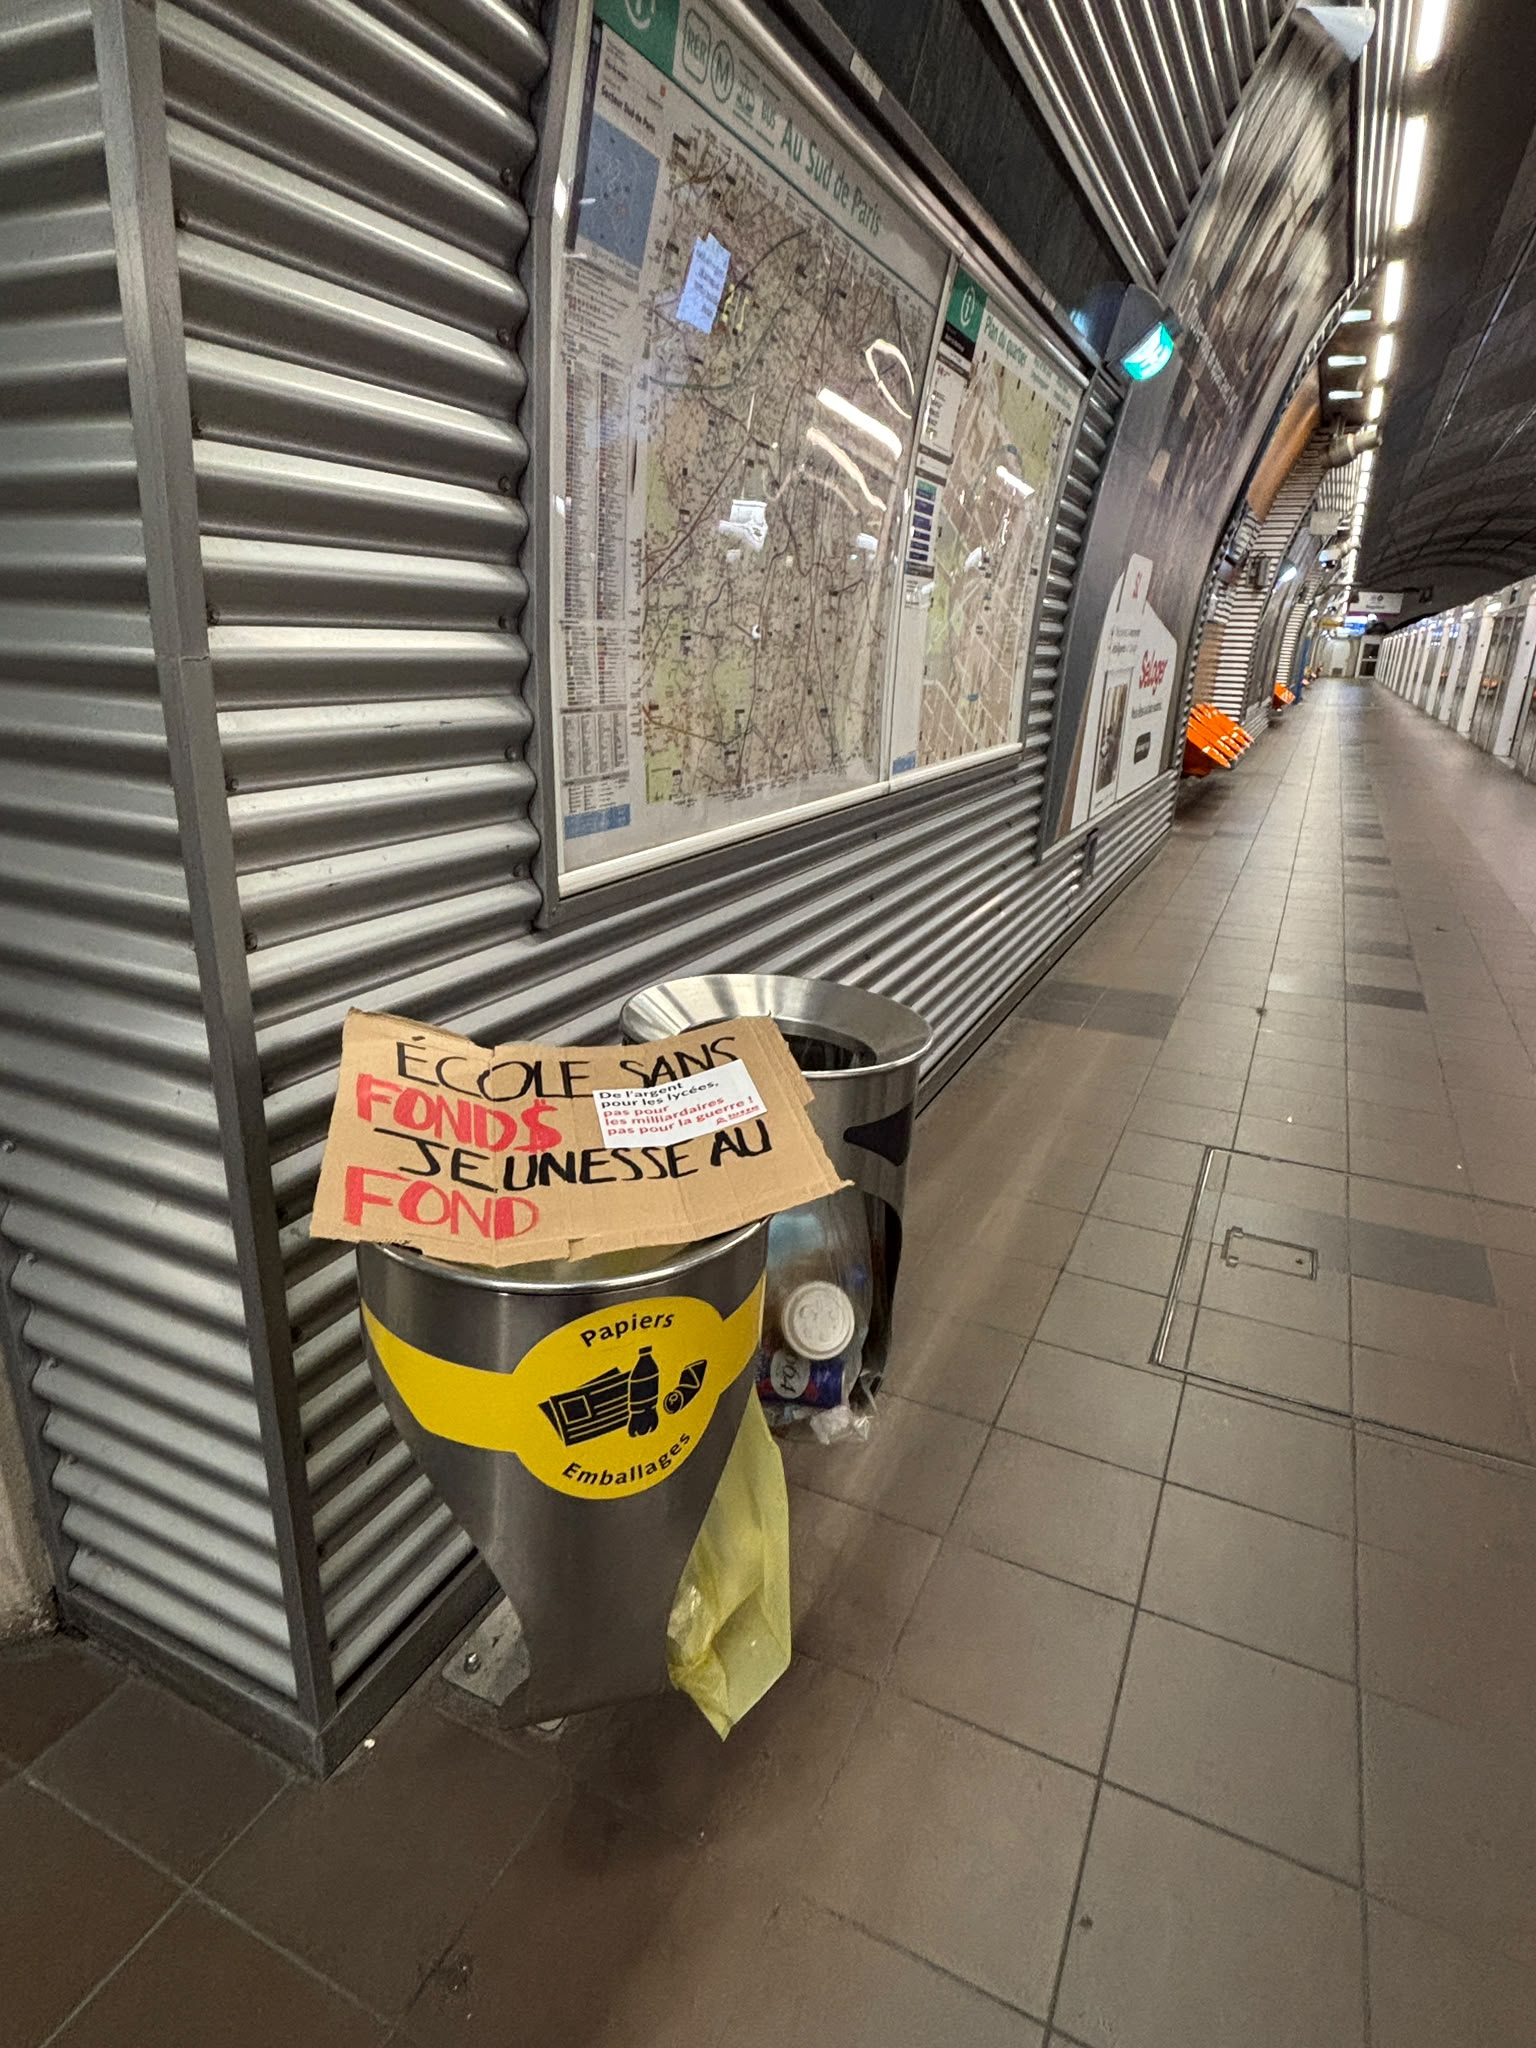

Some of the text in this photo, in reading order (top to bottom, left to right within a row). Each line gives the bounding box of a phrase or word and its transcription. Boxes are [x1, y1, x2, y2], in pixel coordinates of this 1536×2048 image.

[687, 30, 707, 63] RER
[714, 53, 730, 91] M
[781, 118, 880, 237] Au Sud de Paris
[395, 1035, 592, 1101] ÉCOLE
[356, 1072, 563, 1153] FOND$
[600, 1091, 621, 1099] De
[601, 1099, 638, 1109] pour
[643, 1097, 663, 1106] les
[603, 1106, 669, 1118] pas pour
[605, 1116, 627, 1126] les
[632, 1097, 724, 1125] milliardaires
[607, 1126, 635, 1136] pas
[640, 1122, 675, 1135] pour
[679, 1117, 693, 1127] la
[696, 1101, 745, 1122] guerre
[373, 1119, 772, 1193] JEUNESSE AU
[343, 1165, 540, 1240] FOND
[580, 1312, 674, 1348] Papiers
[562, 1431, 691, 1486] Emballages
